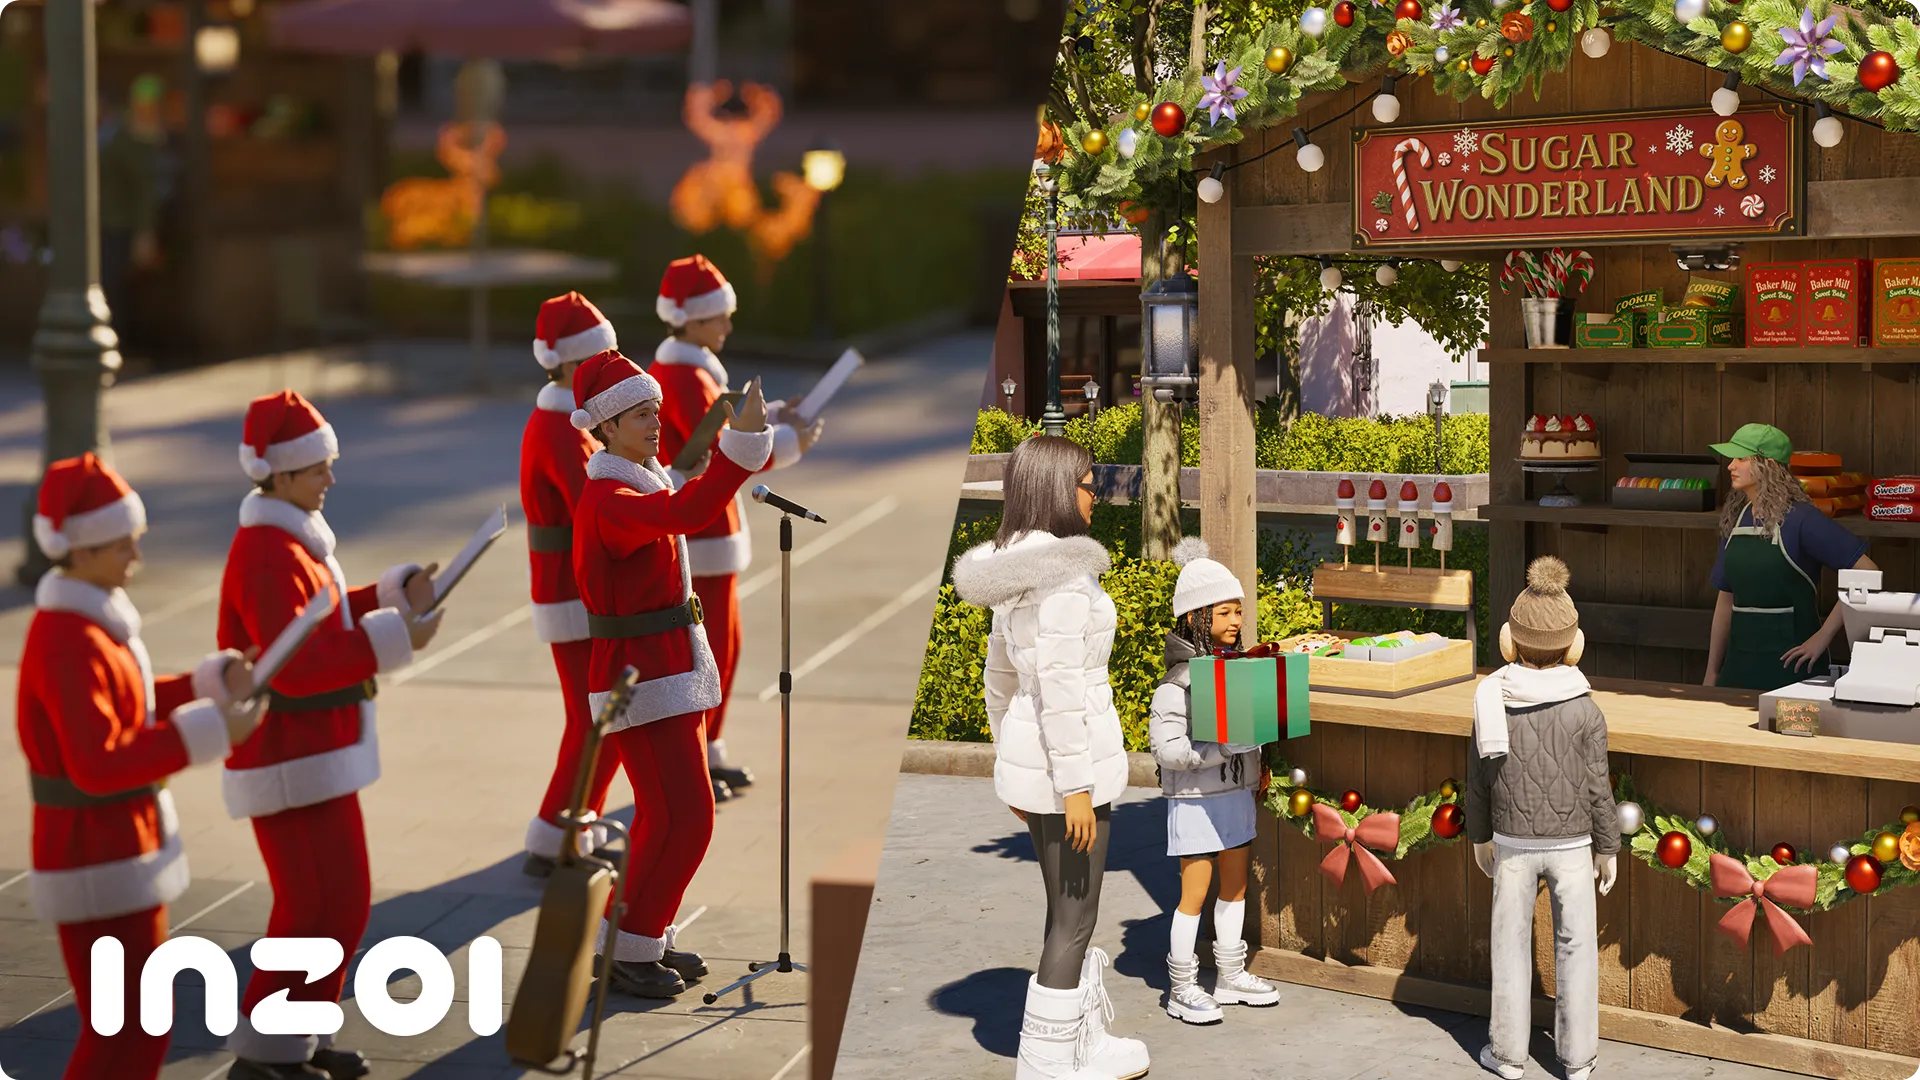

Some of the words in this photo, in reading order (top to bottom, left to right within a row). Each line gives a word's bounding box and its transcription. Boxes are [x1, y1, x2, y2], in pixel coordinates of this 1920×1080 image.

[1479, 132, 1637, 176] SUGAR
[1418, 175, 1704, 222] WONDERLAND
[1755, 280, 1780, 292] Baker
[1780, 279, 1797, 292] Mill
[1810, 278, 1834, 290] Baker
[1834, 277, 1850, 290] Mill
[1884, 276, 1910, 289] Baker
[1688, 284, 1731, 297] COOKIE
[1760, 292, 1777, 301] Sweet
[1777, 291, 1793, 301] Bake
[1814, 290, 1831, 300] Sweet
[1831, 289, 1846, 299] Bake
[1889, 288, 1907, 298] Sweet
[1616, 293, 1657, 313] COOKIE
[1666, 308, 1707, 322] COOK
[1713, 322, 1730, 335] COOKIE
[1875, 483, 1914, 495] Sweeties
[1872, 504, 1912, 516] Sweeties
[1778, 701, 1802, 715] People
[1806, 704, 1819, 712] who
[1800, 714, 1811, 722] to
